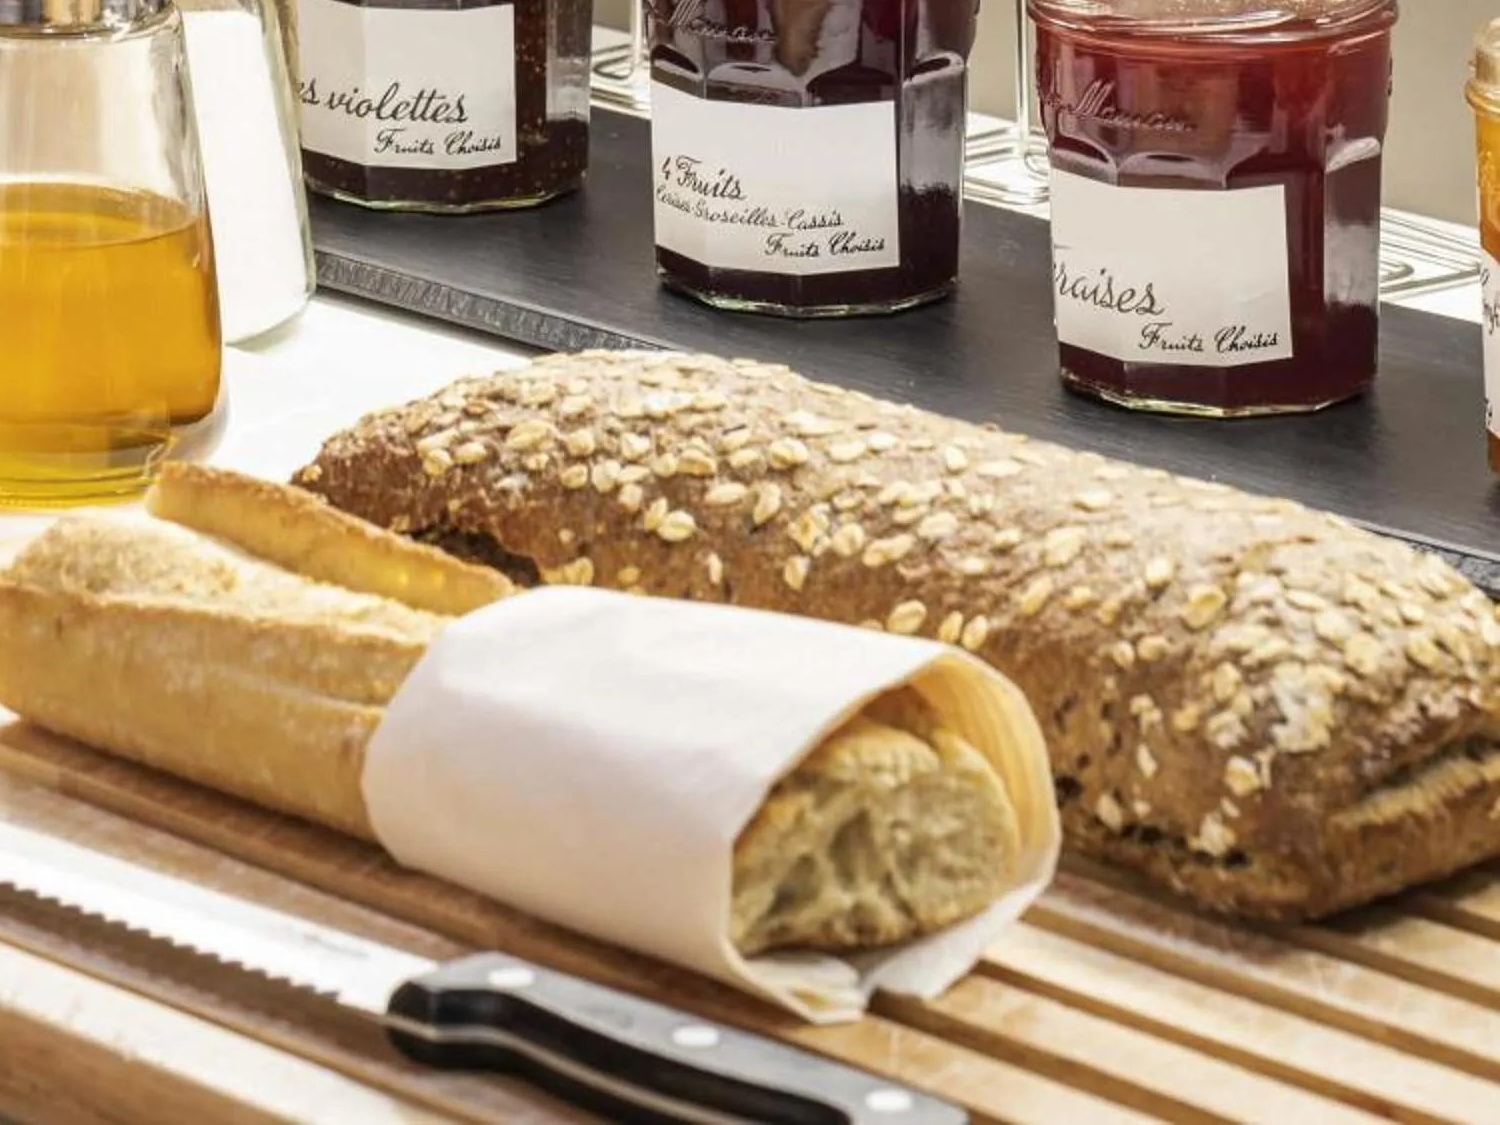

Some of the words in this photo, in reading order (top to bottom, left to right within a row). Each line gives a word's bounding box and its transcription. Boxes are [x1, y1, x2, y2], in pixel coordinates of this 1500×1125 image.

[326, 82, 468, 124] violettes
[374, 127, 435, 155] Fruits
[444, 130, 501, 155] Choisis
[661, 156, 672, 180] 4
[675, 155, 746, 200] Fruits
[764, 232, 820, 257] Fruits
[827, 231, 884, 256] Choisis
[1053, 244, 1164, 316] raises
[1138, 323, 1204, 352] Fruits
[1214, 325, 1279, 353] Choisis
